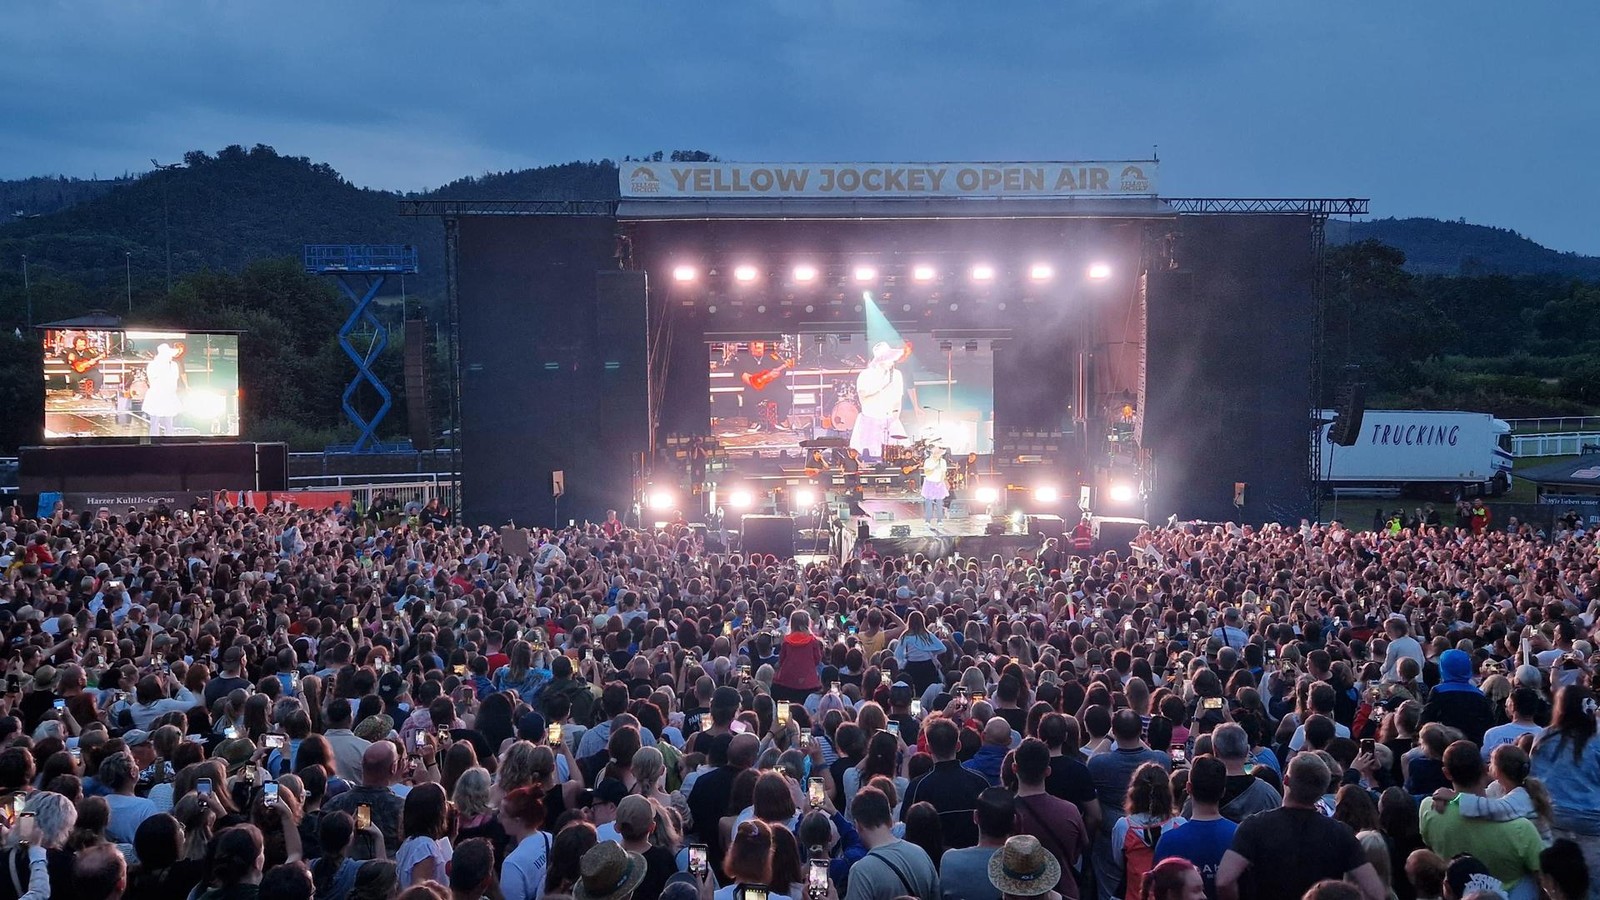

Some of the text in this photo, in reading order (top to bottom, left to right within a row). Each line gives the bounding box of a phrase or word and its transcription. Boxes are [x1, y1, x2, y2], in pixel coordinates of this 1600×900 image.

[670, 167, 1110, 192] YELLOW JOCKEY OPEN AIR
[1371, 424, 1460, 447] TRUCKING
[87, 497, 114, 505] Harzer
